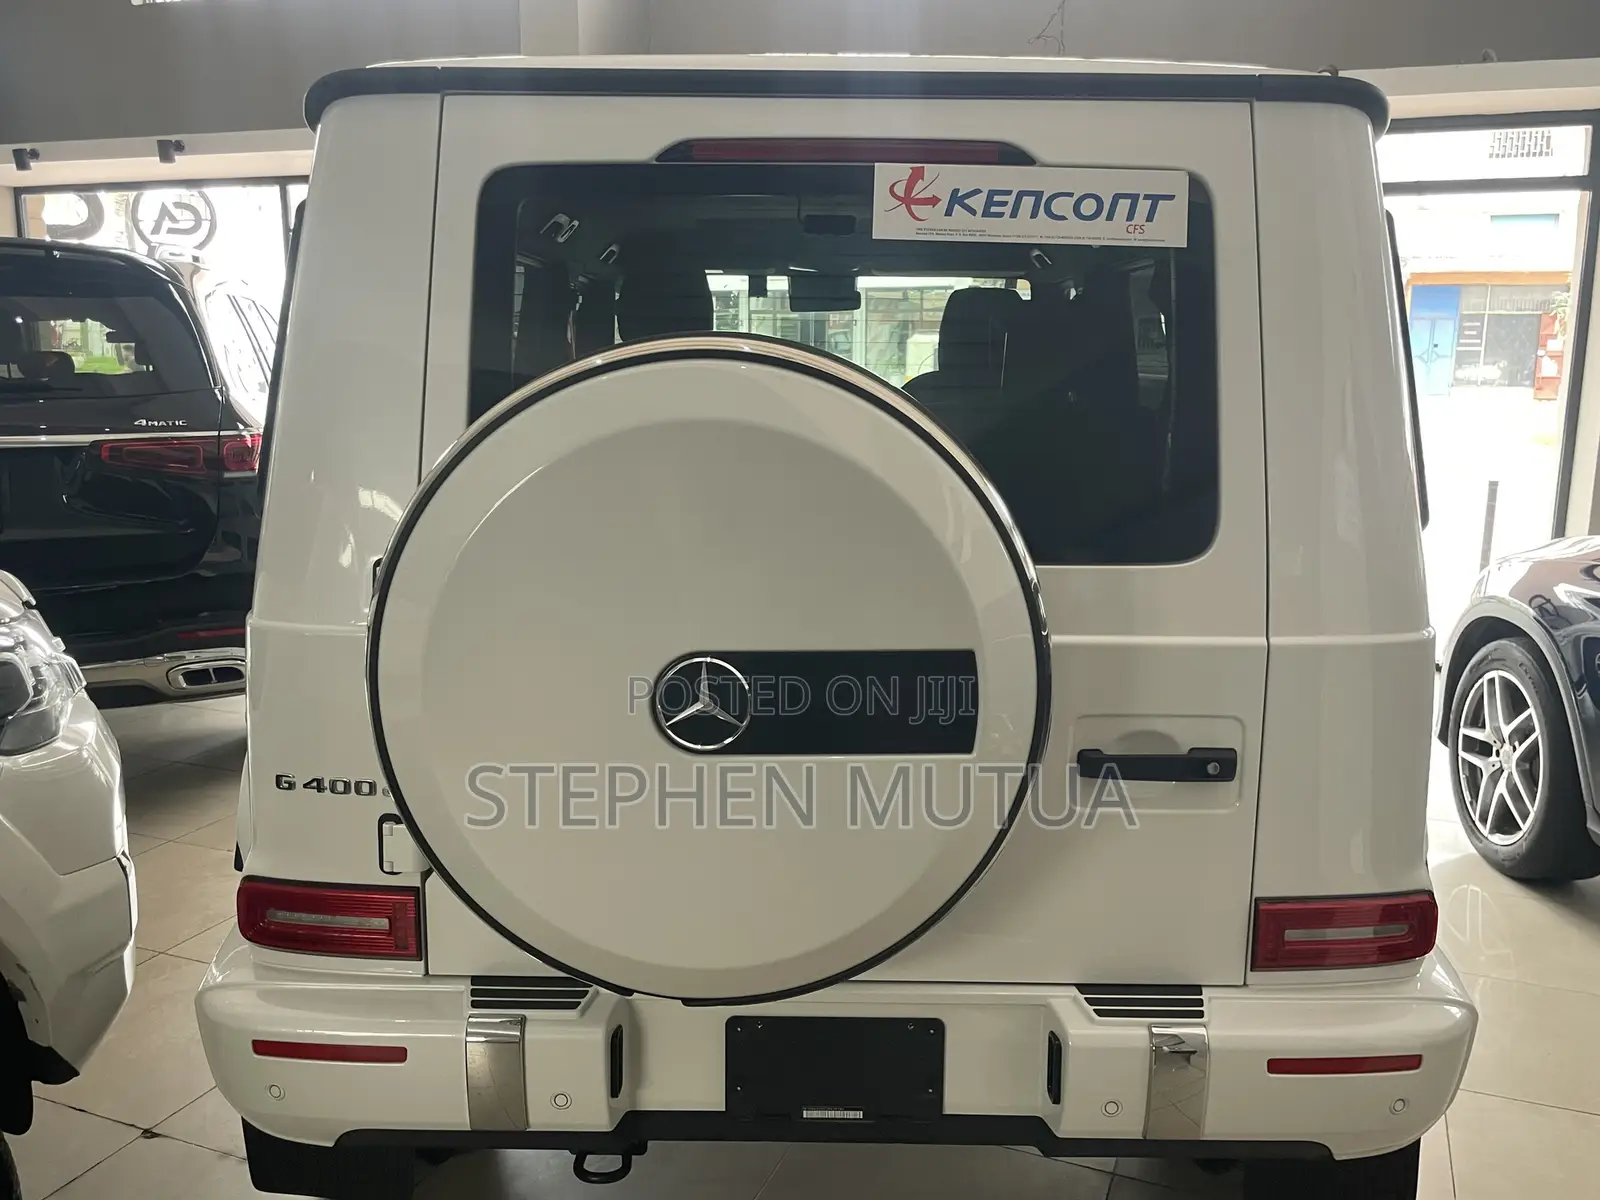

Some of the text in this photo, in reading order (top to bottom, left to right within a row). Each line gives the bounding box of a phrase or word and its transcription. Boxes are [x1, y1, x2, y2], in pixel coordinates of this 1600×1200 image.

[1126, 224, 1146, 235] CFS
[133, 418, 188, 427] 4MATIC
[275, 772, 297, 791] G
